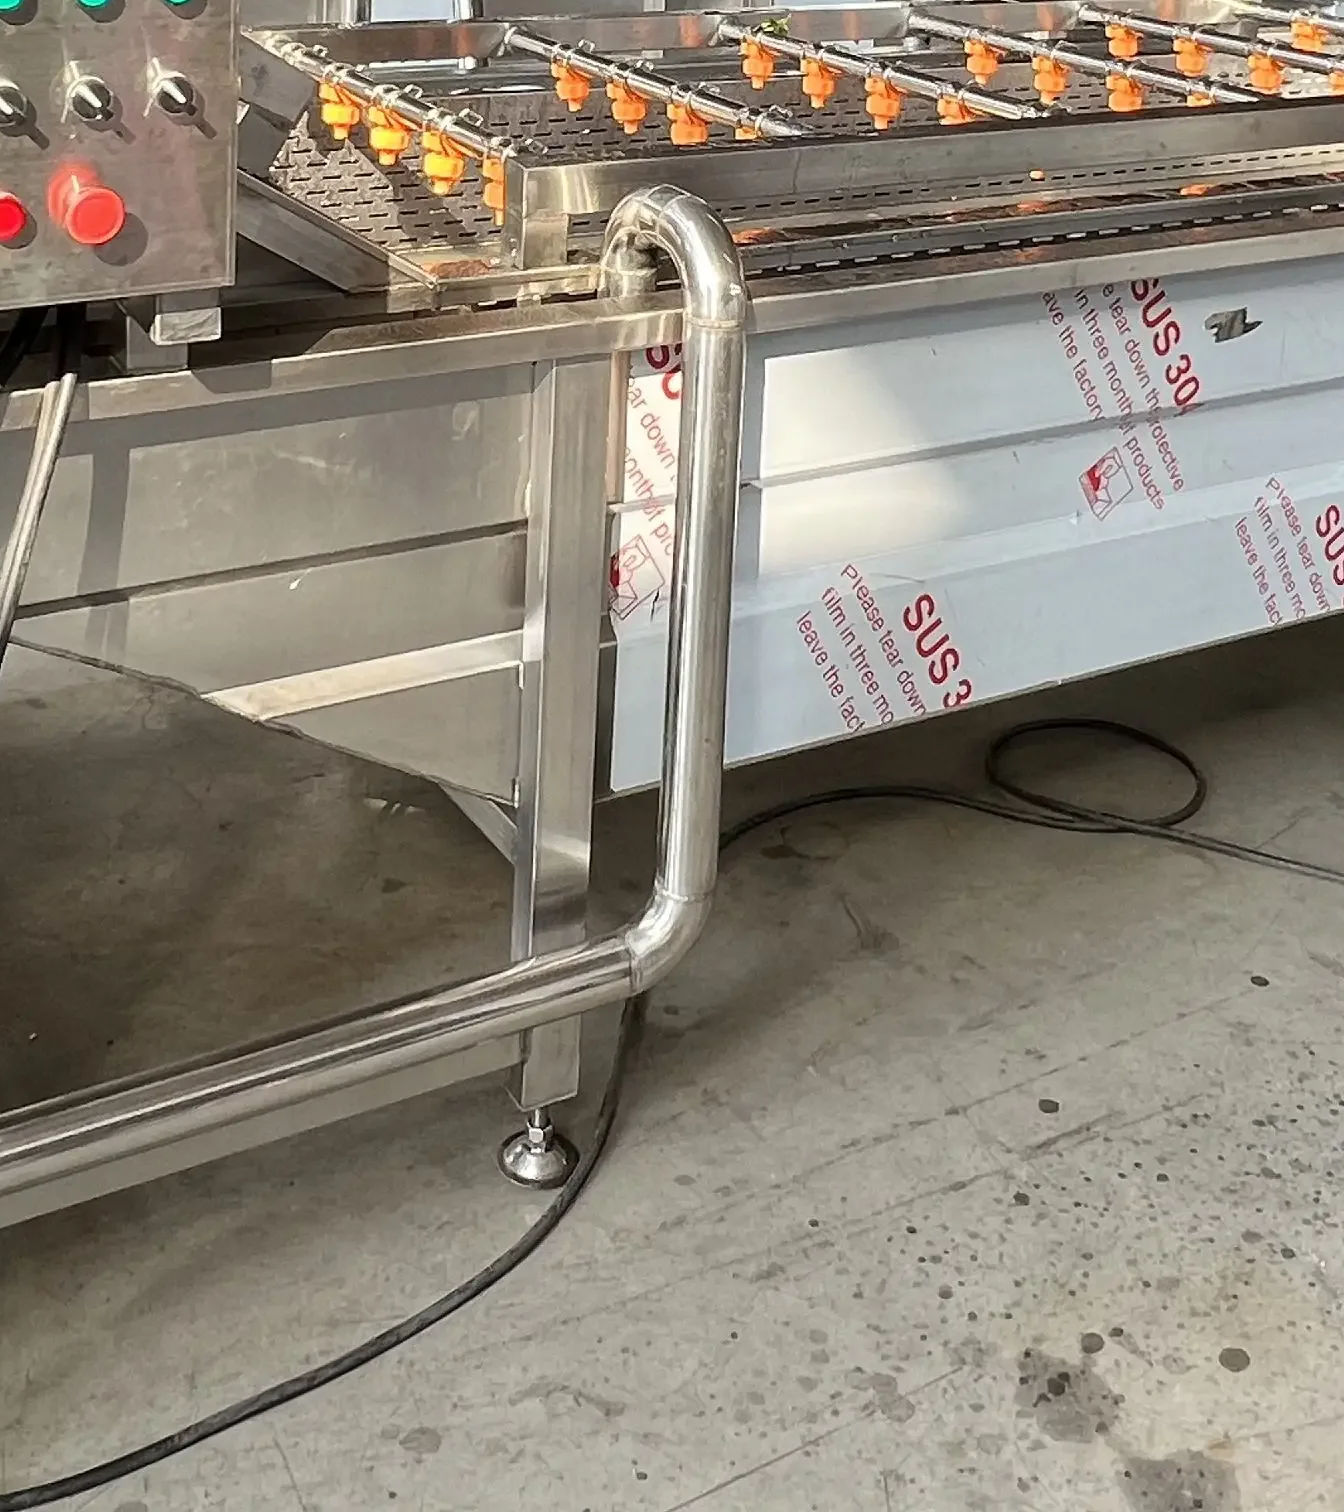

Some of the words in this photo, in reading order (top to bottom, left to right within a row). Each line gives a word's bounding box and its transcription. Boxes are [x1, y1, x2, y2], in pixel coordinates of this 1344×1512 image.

[1058, 325, 1079, 359] the
[1082, 308, 1110, 360] three
[1108, 296, 1132, 335] tear
[1124, 338, 1151, 389] down
[640, 411, 676, 469] down
[1123, 436, 1165, 510] products
[1235, 516, 1258, 566] leave
[1253, 564, 1269, 595] the
[1265, 477, 1302, 537] Please
[1297, 536, 1315, 569] tear
[1266, 528, 1280, 550] in
[1274, 547, 1296, 594] three
[796, 610, 829, 666] leave
[822, 664, 844, 698] the
[821, 586, 847, 628] film
[839, 625, 856, 648] in
[849, 643, 880, 696] three
[840, 564, 885, 632] Please
[878, 629, 904, 668] tear
[903, 594, 960, 684] SUS
